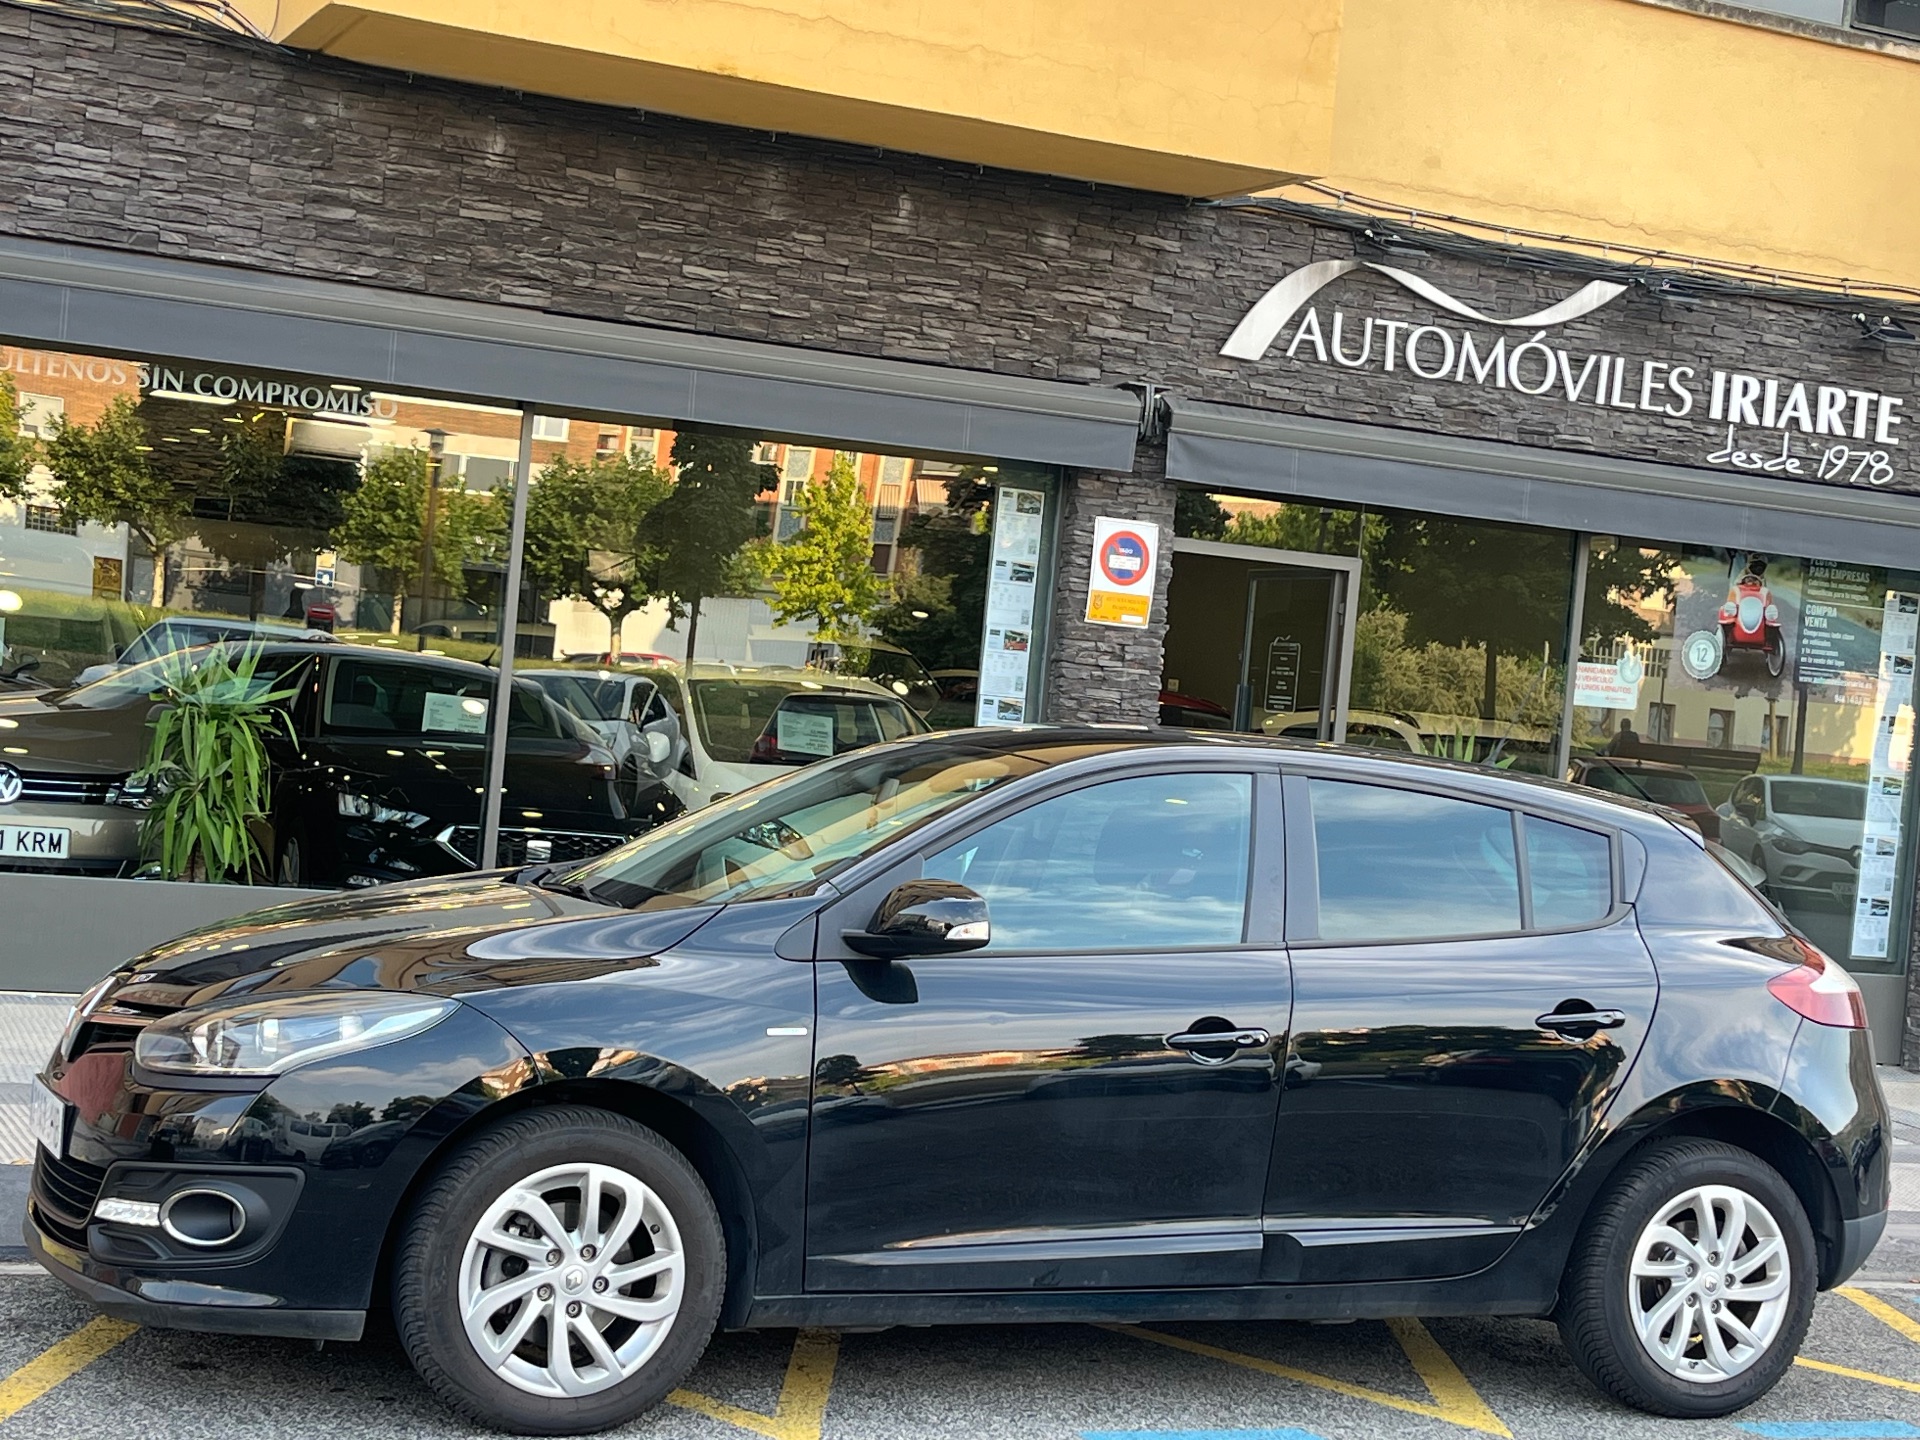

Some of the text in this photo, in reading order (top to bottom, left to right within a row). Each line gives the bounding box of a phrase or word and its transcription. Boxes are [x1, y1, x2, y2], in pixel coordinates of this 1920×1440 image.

[1286, 306, 1904, 445] AUTOMÓVILES IRIARTE
[137, 362, 184, 392] SIN
[193, 373, 398, 420] COMPROMISO
[1706, 423, 1895, 486] desde 1978
[1804, 616, 1828, 629] VENTA
[1805, 604, 1838, 618] COMPRA
[1696, 647, 1708, 663] 12
[16, 830, 62, 853] KRM
